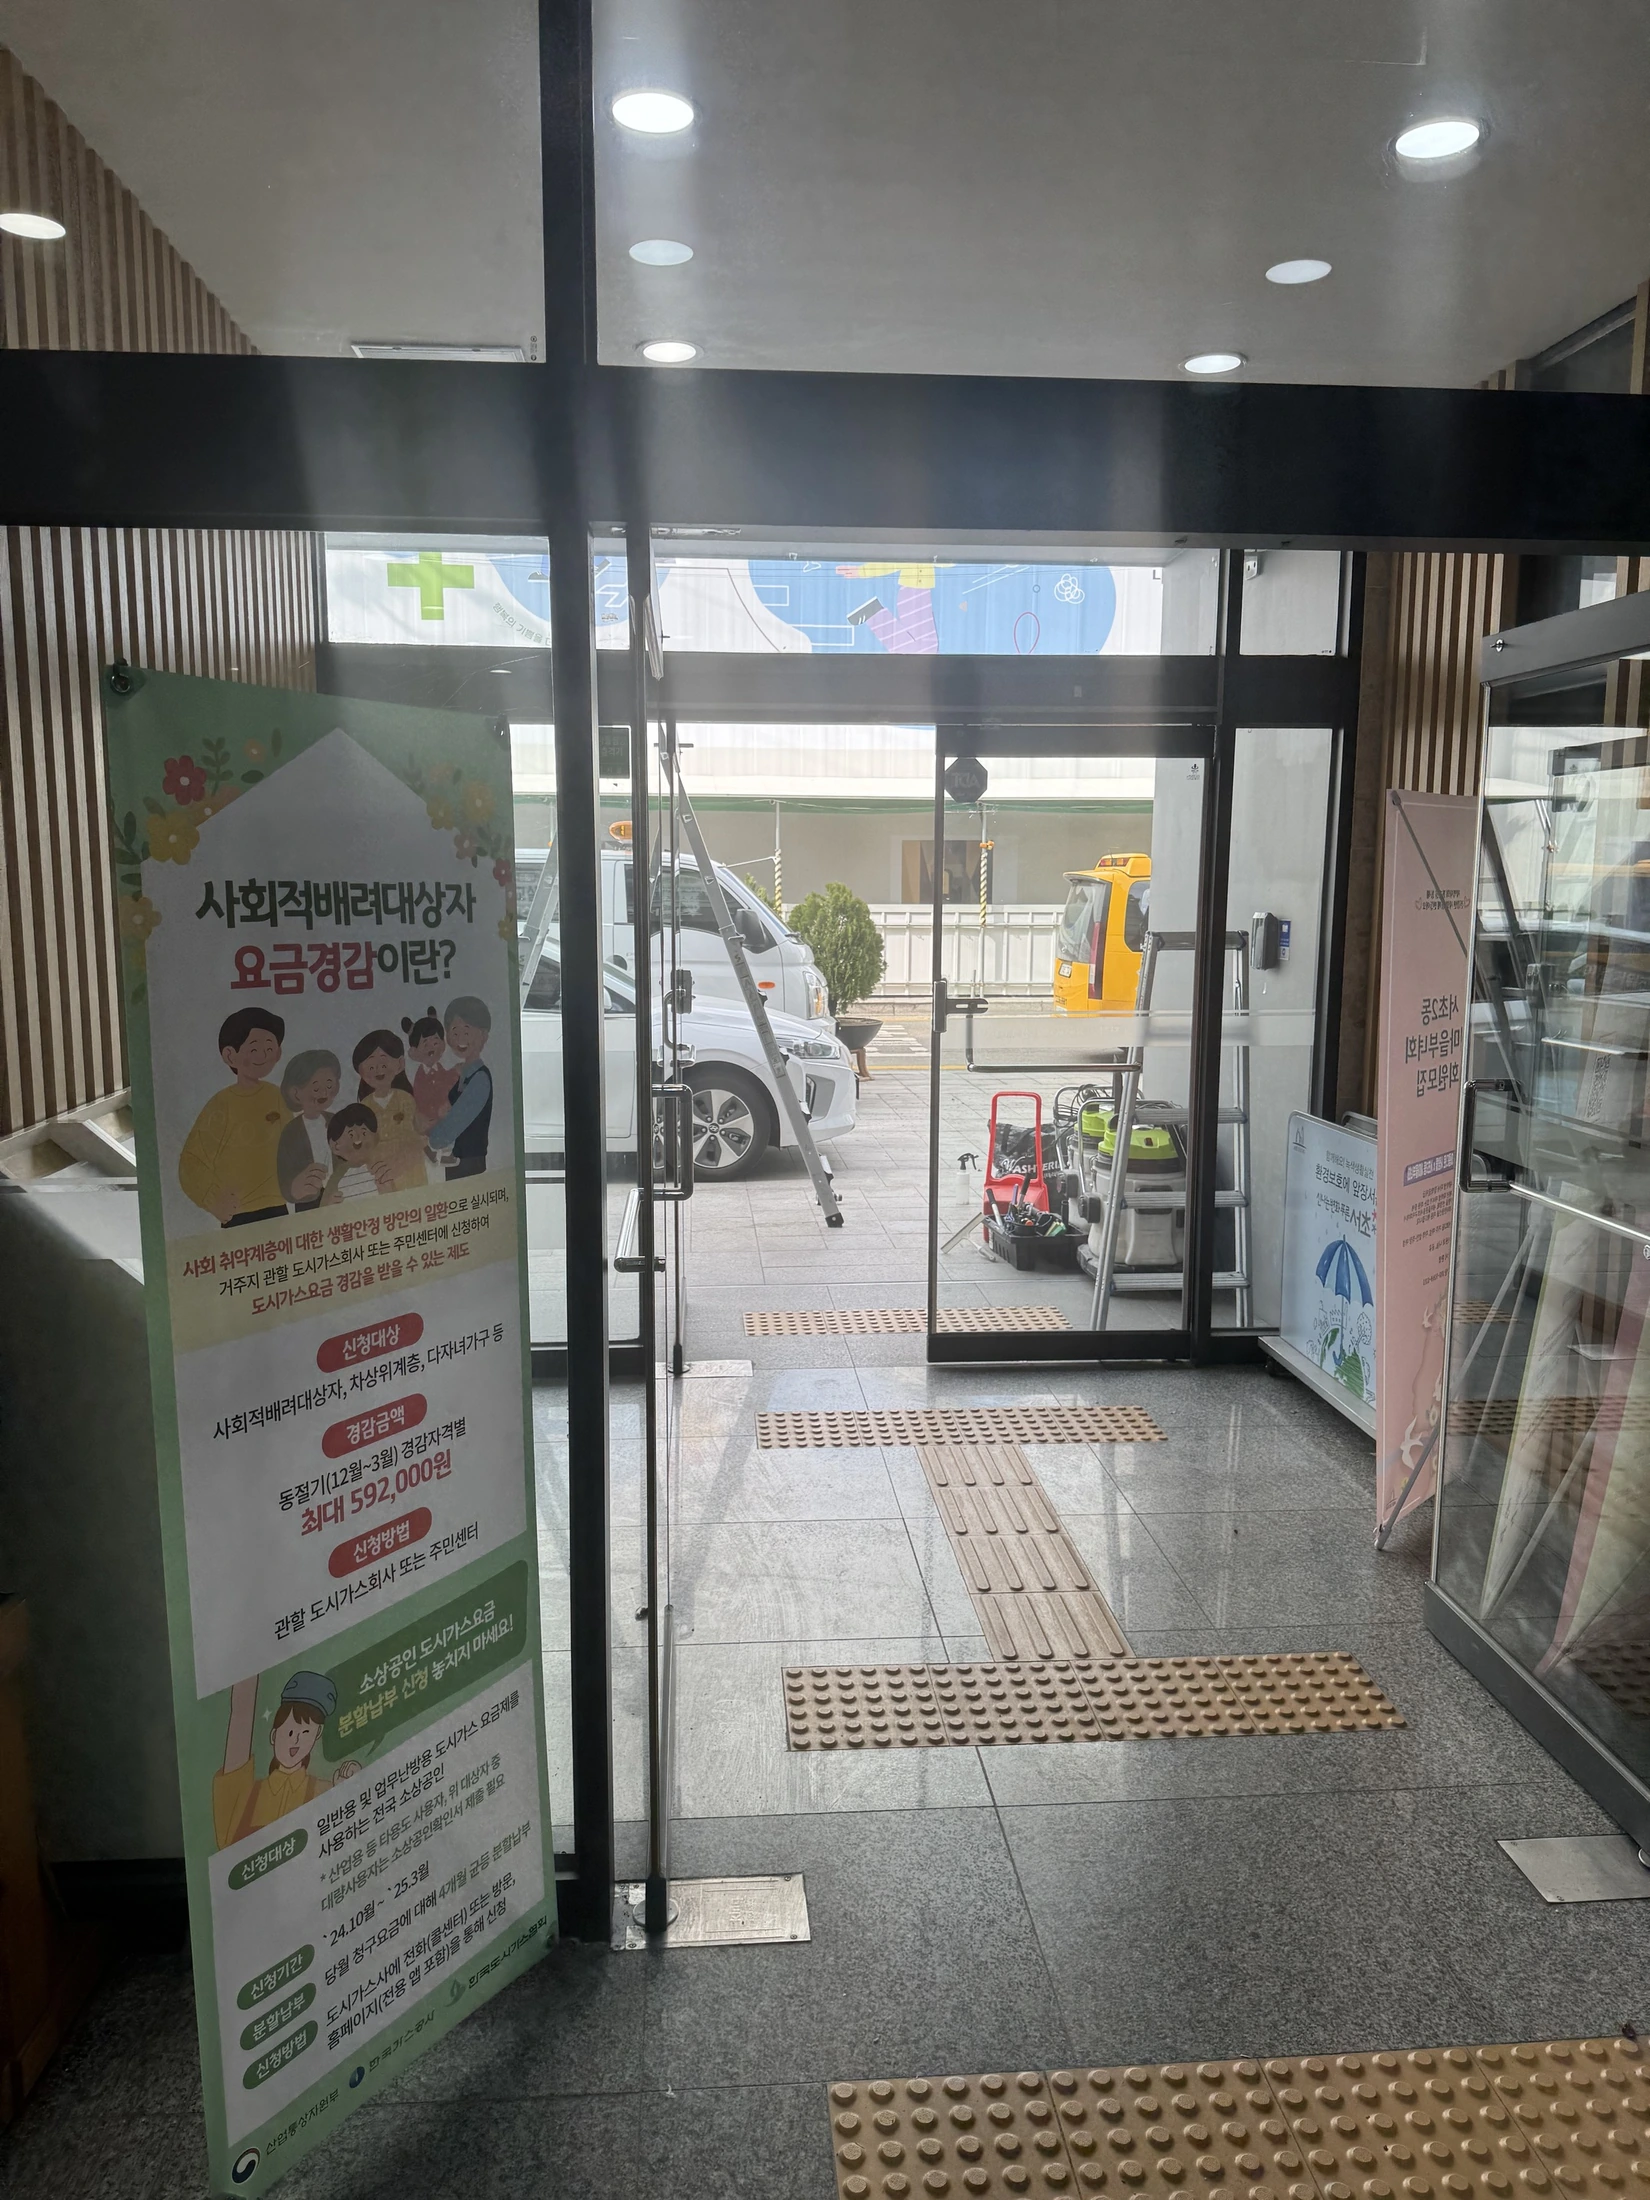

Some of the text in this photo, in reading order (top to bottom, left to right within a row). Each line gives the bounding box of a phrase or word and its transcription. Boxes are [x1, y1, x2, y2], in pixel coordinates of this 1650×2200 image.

[195, 878, 476, 931] 사회적배려대상자
[229, 937, 457, 995] 요금경감이란?
[1315, 1163, 1377, 1205] 환경보호에 앞장서
[183, 1187, 509, 1277] 사회 취약계층에 대한 생활안정 방안의 일환으로 실시되며,
[219, 1213, 490, 1297] 거주지 관할 도시가스회사 또는 주민센터에 신청하여
[251, 1241, 470, 1315] 도시가스요금 경감을 받을 수 있는 제도
[213, 1322, 504, 1441] 사회적배려대상자, 차상위계층, 다자녀가구 등
[342, 1323, 401, 1362] 신청대상
[279, 1415, 467, 1511] 동절기(12월~3월) 경감자격별
[346, 1404, 405, 1445] 경감금액
[301, 1449, 452, 1536] 최대 592,000원
[274, 1521, 479, 1640] 관할 도시가스회사 또는 주민센터
[353, 1519, 410, 1564] 신청방법
[336, 1617, 514, 1739] 분할납부 신청 놓치지 마세요!
[359, 1600, 497, 1695] 소상공인 도시가스요금
[316, 1689, 520, 1837] 일반용 및 업무난방용 도시가스 요금제를
[486, 1773, 506, 1796] 필요
[318, 1762, 445, 1859] 사용하는 전국 소상공인
[366, 1841, 377, 1860] 등
[379, 1818, 413, 1846] 타용도
[449, 1780, 459, 1800] 위
[460, 1766, 490, 1791] 대상자
[241, 1837, 296, 1881] 신청대상
[324, 1820, 532, 1986] 당월 청구요금에 대해 4개월 균등 분할납부
[250, 1952, 303, 2000] 신청기간
[326, 1958, 401, 2027] 도시가스사에
[468, 1891, 491, 1918] 또는
[491, 1871, 516, 1897] 방문,
[327, 1897, 507, 2051] 홈페이지(전용 앱 포함)을 통해 신청
[252, 1992, 306, 2041] 분할납부
[255, 2029, 307, 2080] 신청방법
[266, 2088, 339, 2155] 산업통상자원부
[369, 2009, 435, 2073] 한국가스공사
